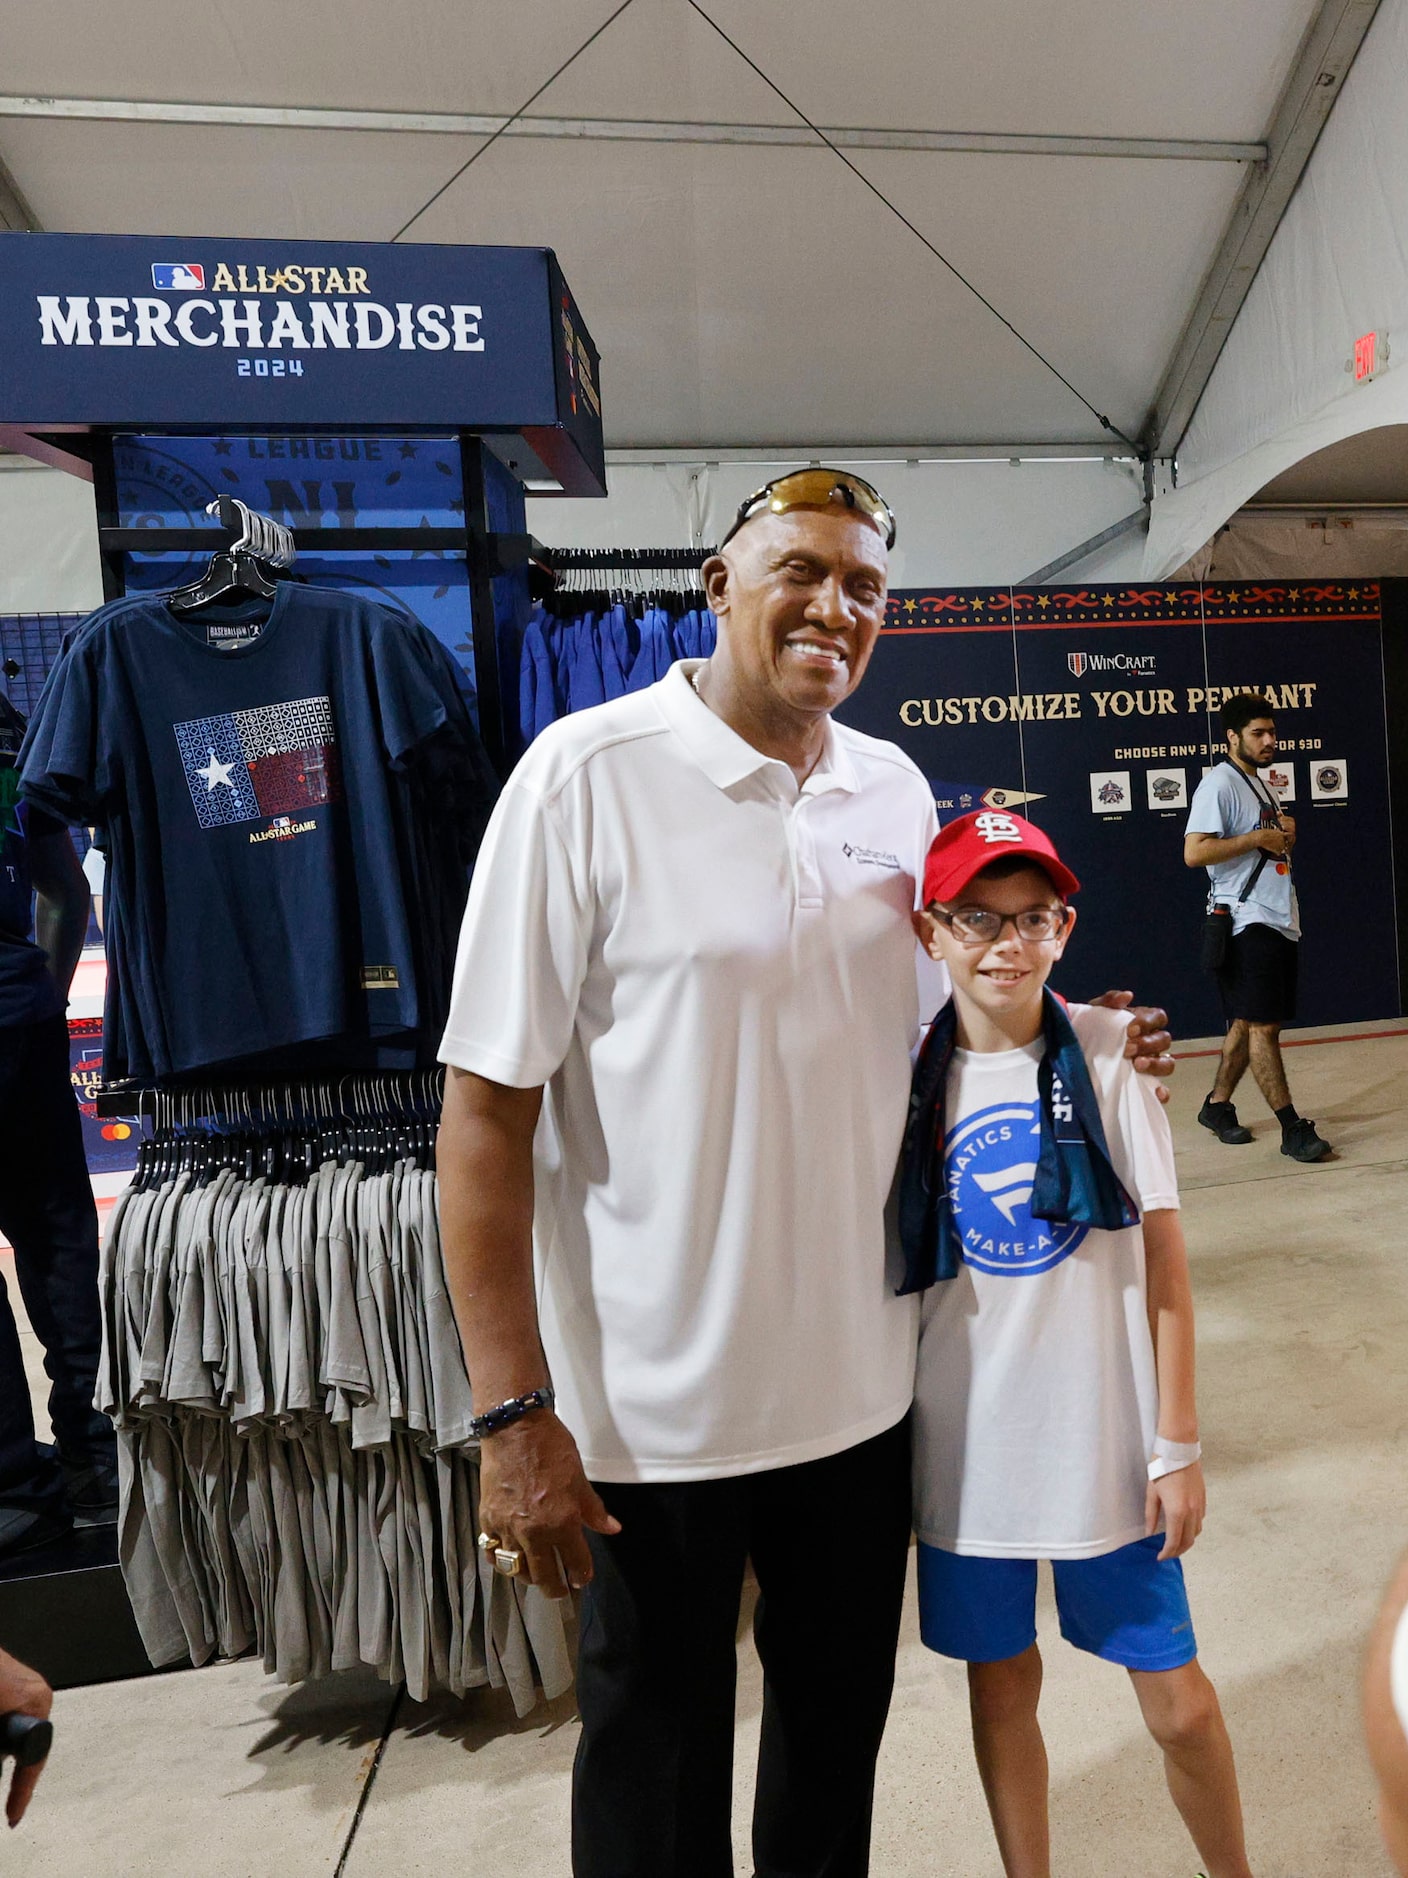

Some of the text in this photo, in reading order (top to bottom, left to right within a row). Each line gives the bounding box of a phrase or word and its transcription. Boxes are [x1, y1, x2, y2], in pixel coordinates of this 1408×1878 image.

[36, 296, 485, 351] MERCHANDISE
[237, 358, 304, 377] 2024
[247, 439, 382, 460] LEAGUE
[899, 692, 1082, 727] CUSTOMIZE
[1090, 688, 1178, 717] YOUR
[1115, 746, 1166, 759] CHOOSE
[1170, 744, 1197, 757] ANY
[1200, 744, 1208, 755] 3
[1299, 738, 1322, 750] $30
[291, 820, 316, 833] GAME
[948, 1126, 1012, 1215] FANATICS
